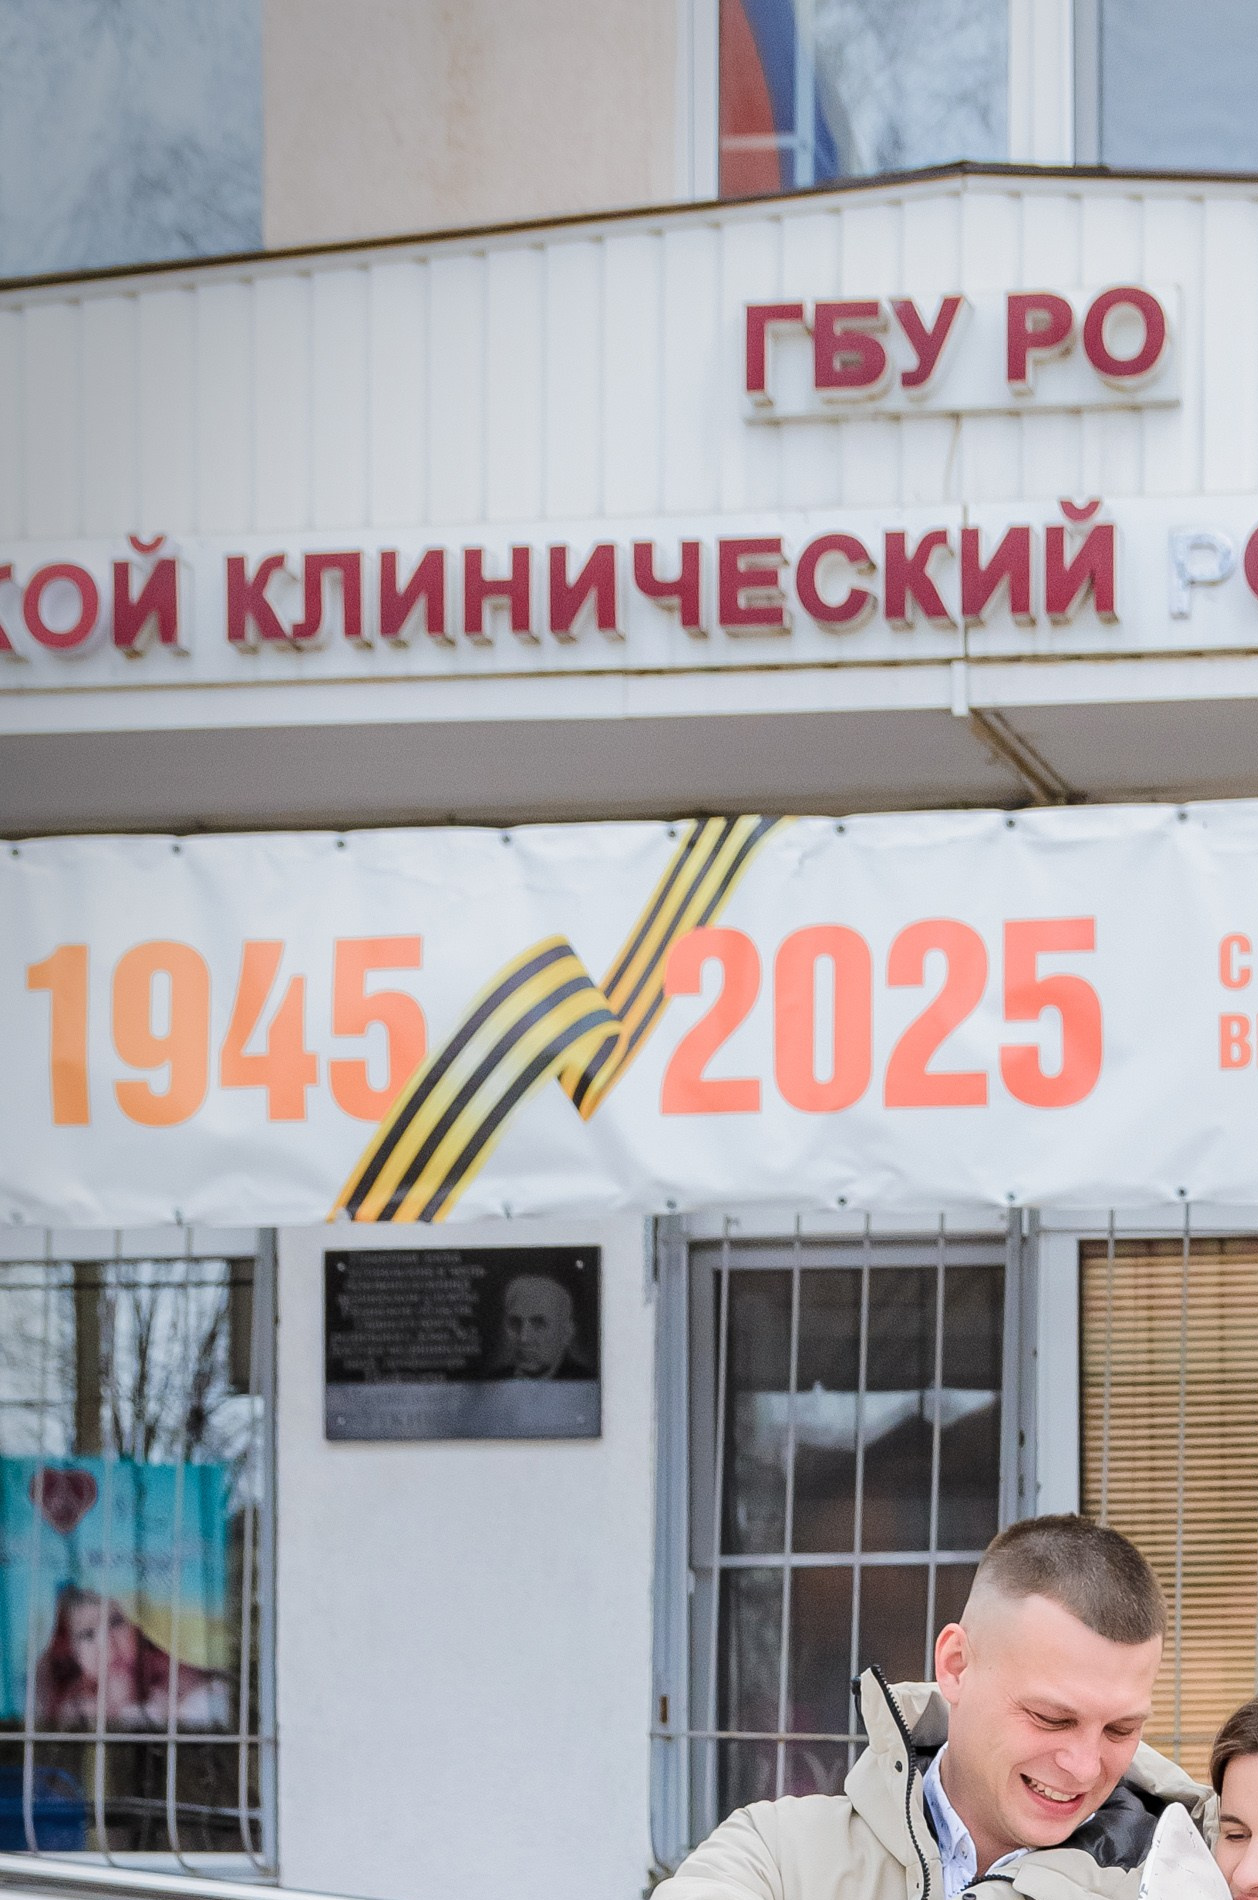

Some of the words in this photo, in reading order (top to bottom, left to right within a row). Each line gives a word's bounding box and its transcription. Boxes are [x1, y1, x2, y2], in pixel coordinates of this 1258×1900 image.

[745, 296, 962, 392] ГБУ
[1006, 286, 1167, 382] РО
[0, 535, 178, 651] ОЙ
[226, 500, 1116, 641] КЛИНИЧЕСКИЙ
[25, 934, 428, 1127] 1945
[660, 917, 1103, 1115] 2025
[1219, 932, 1253, 990] С
